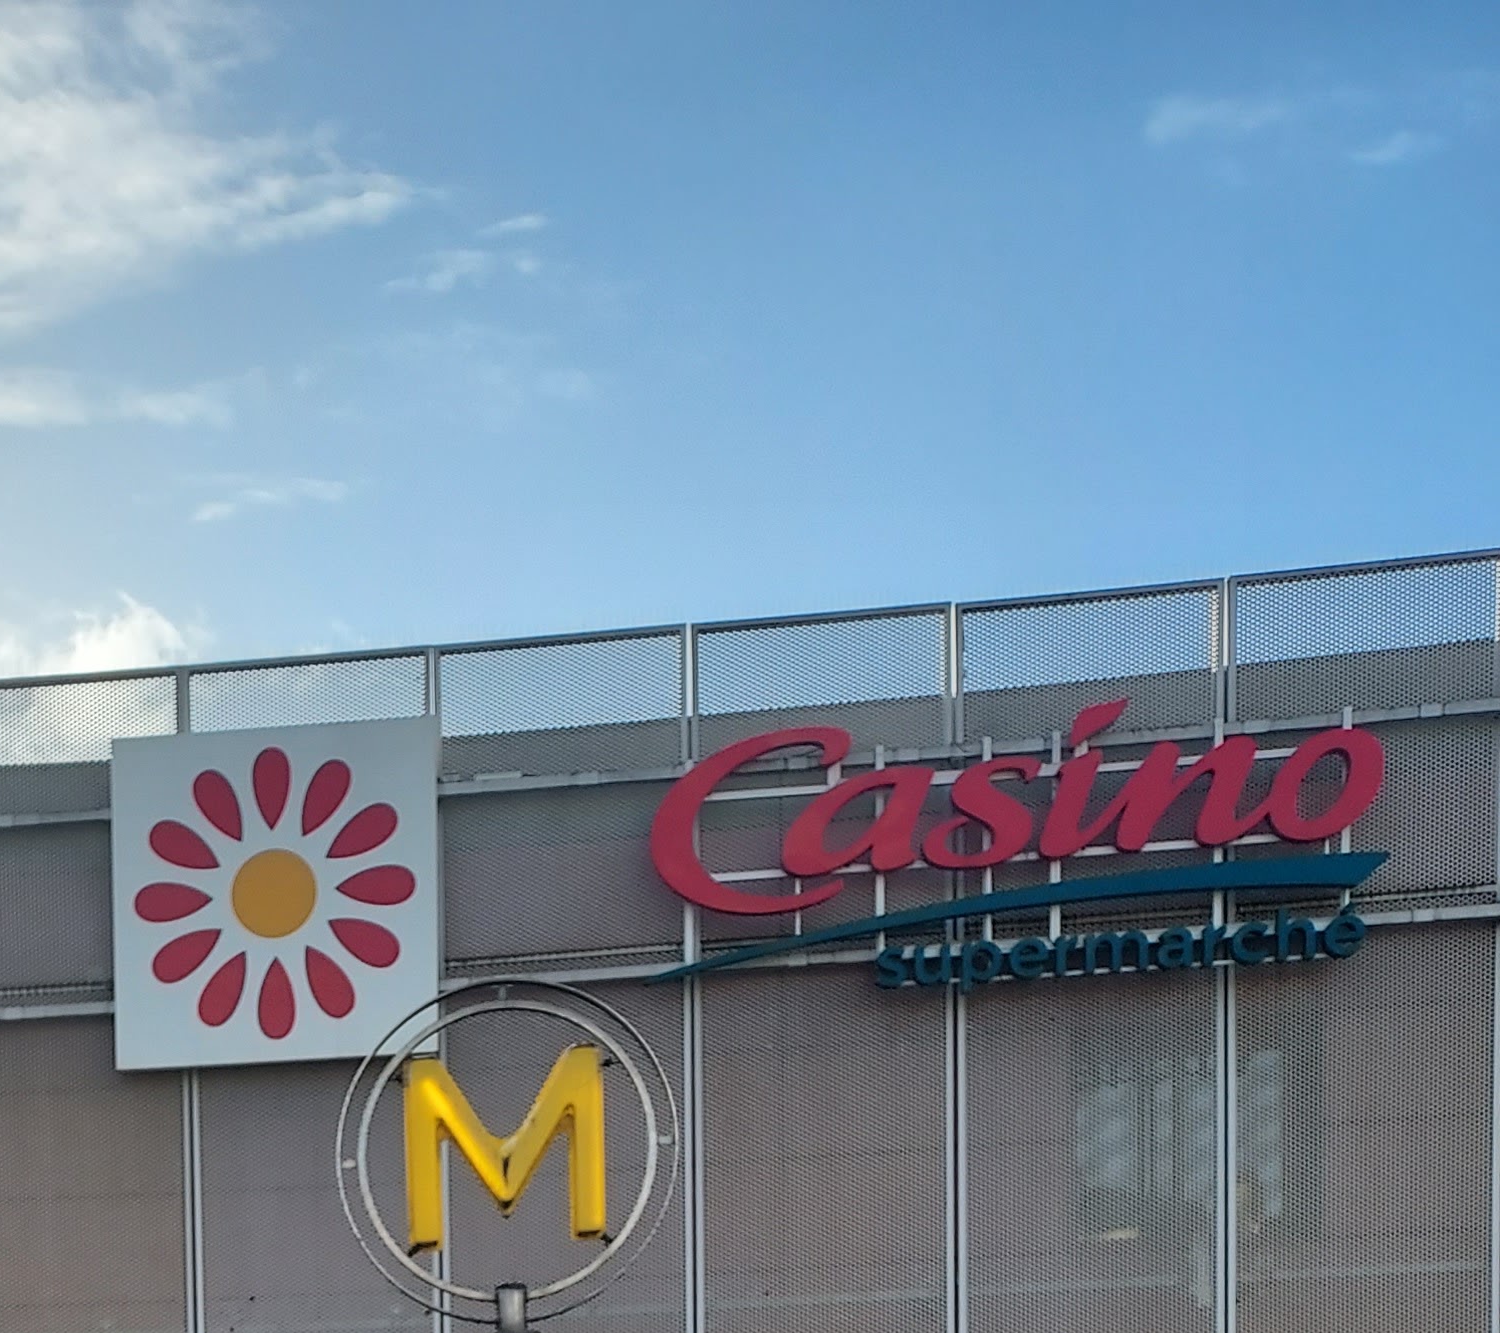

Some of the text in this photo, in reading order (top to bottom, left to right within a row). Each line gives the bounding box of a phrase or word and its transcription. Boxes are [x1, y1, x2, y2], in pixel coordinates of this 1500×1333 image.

[649, 698, 1386, 914] Casino
[875, 903, 1367, 994] supermarché
[404, 1044, 606, 1250] M
